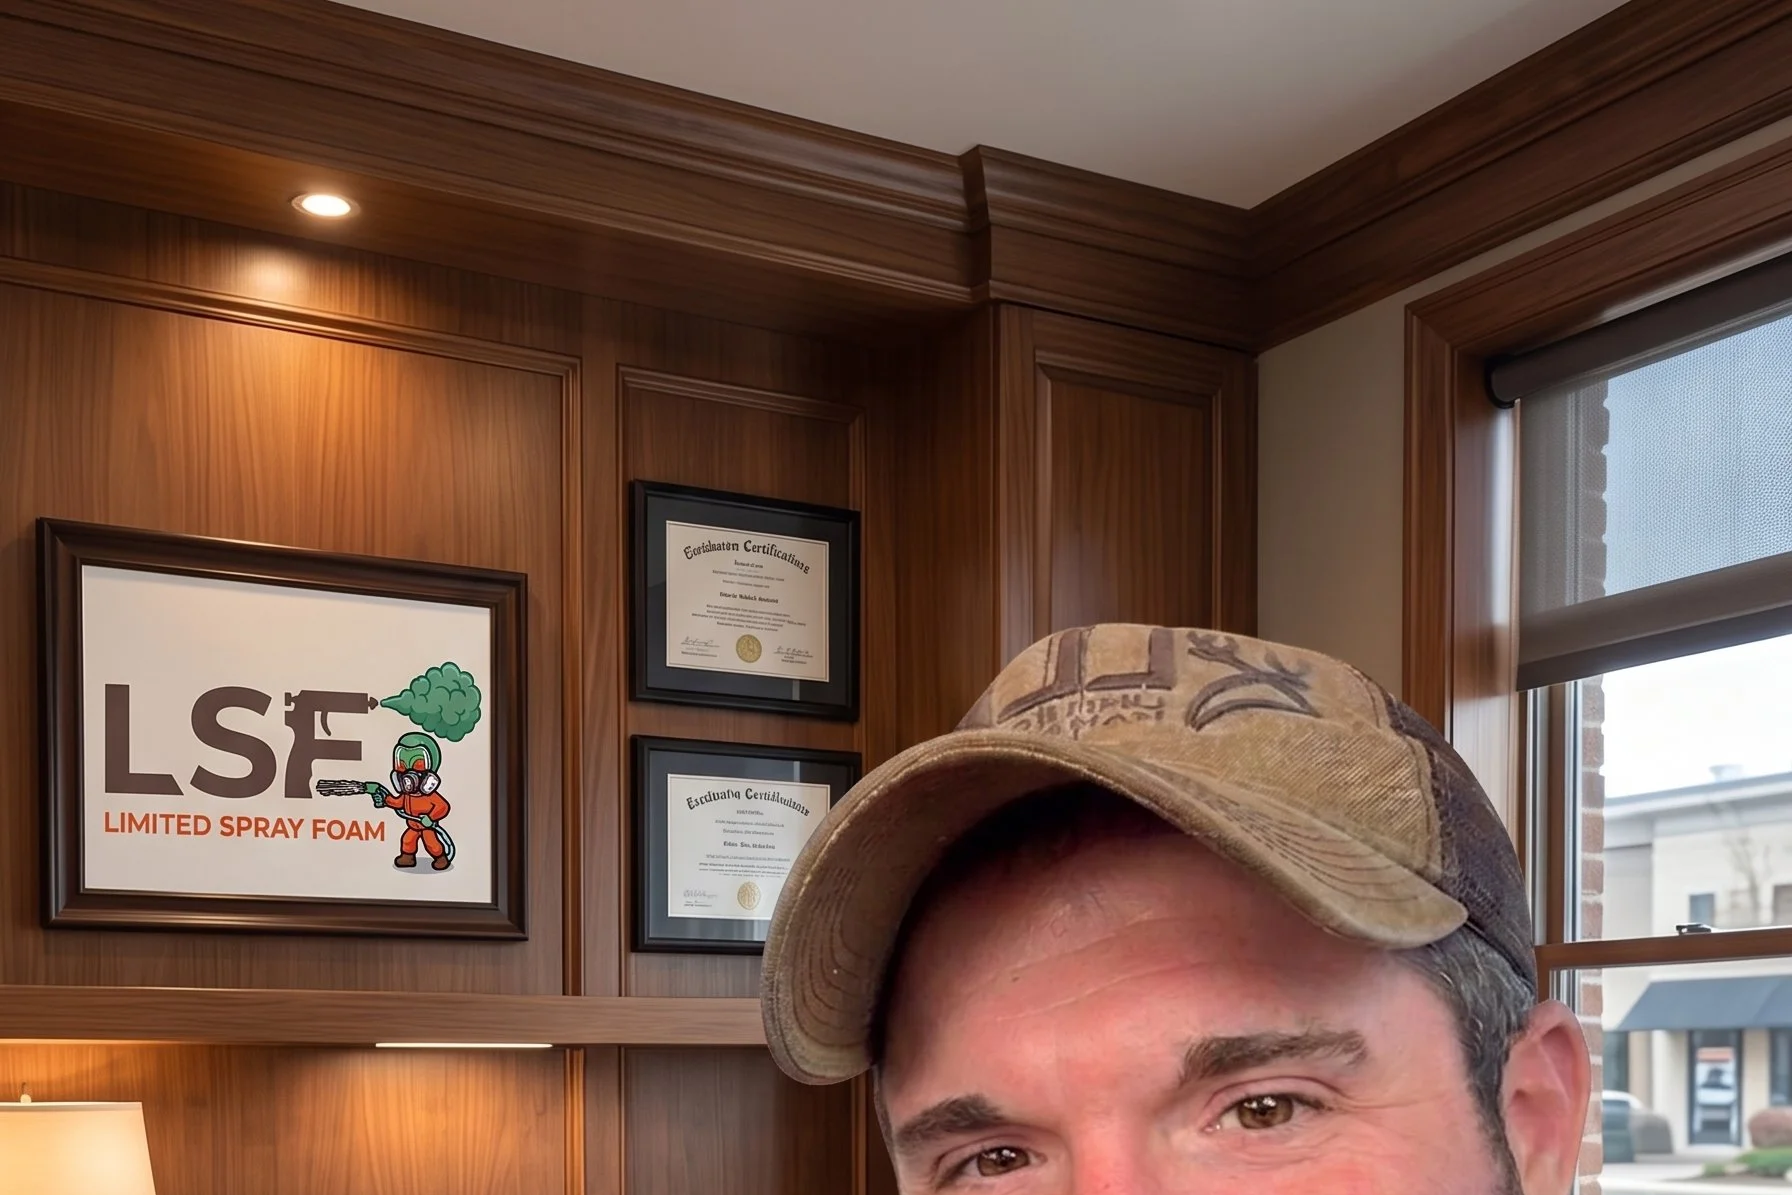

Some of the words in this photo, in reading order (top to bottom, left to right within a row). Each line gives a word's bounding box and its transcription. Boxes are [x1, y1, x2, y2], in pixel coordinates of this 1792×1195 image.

[104, 683, 379, 799] LSF
[104, 811, 213, 837] LIMITED
[219, 815, 305, 839] SPRAY
[312, 817, 386, 842] FOAM
